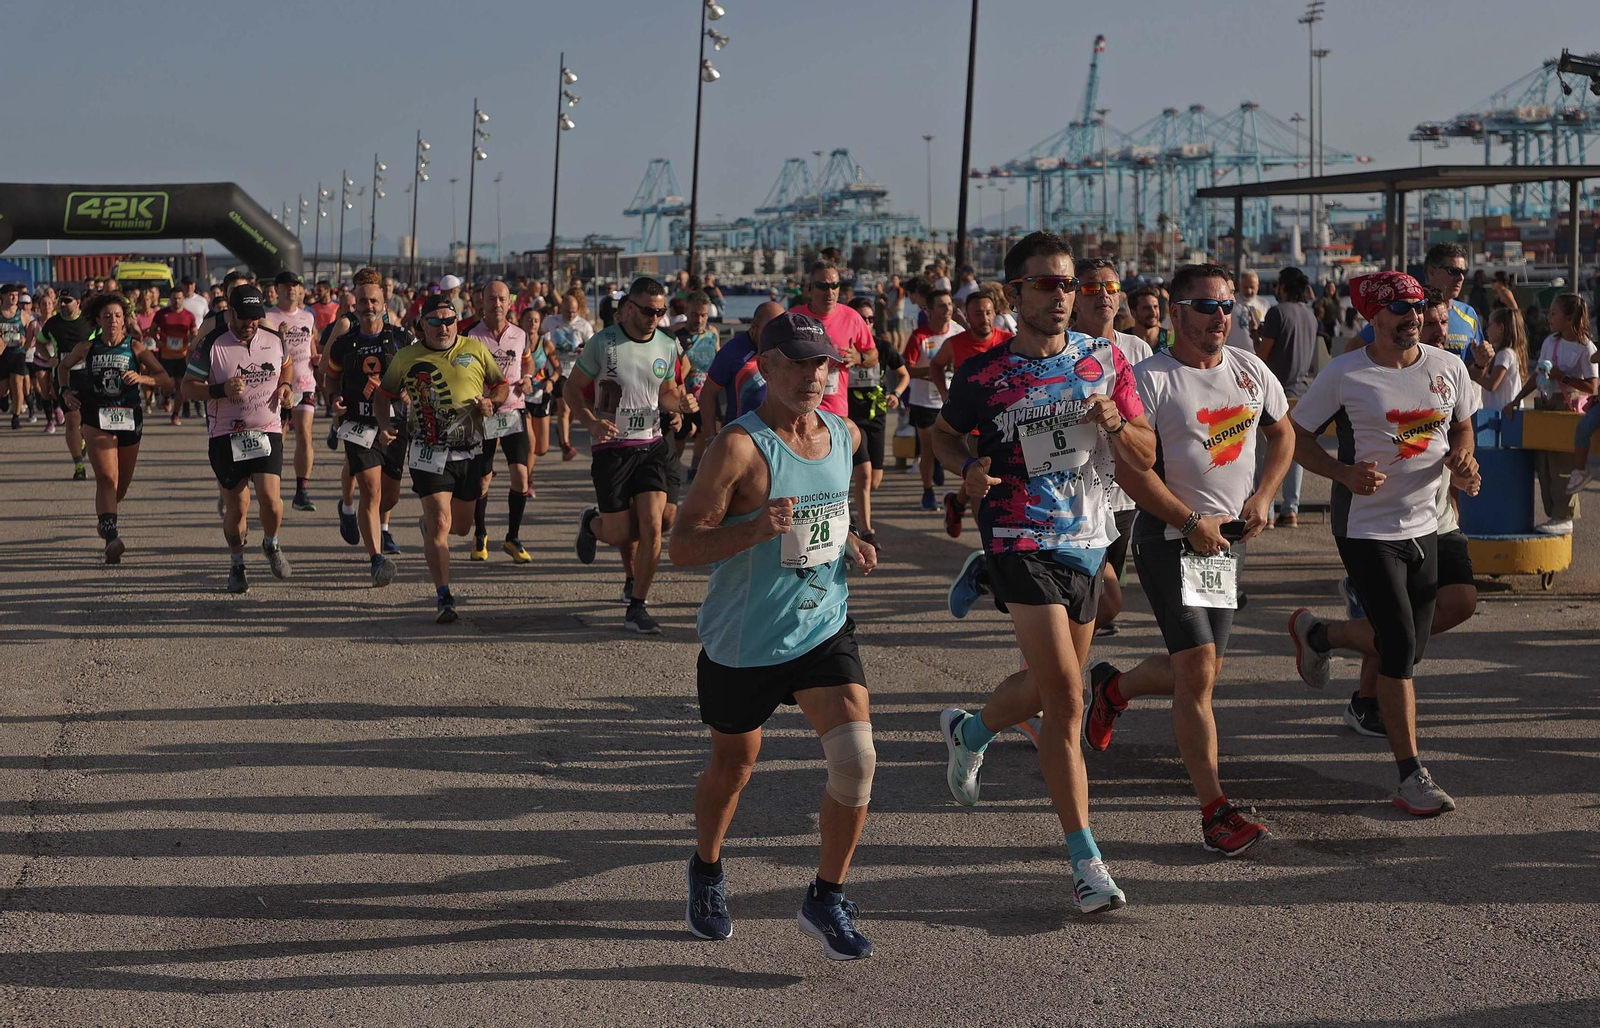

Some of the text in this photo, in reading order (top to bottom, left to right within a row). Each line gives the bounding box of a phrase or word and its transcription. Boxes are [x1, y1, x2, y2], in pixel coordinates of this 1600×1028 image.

[76, 197, 156, 220] 42K
[108, 218, 152, 230] running
[228, 210, 278, 254] 42krunning.com
[860, 370, 871, 380] 61
[110, 414, 124, 422] 197
[1016, 404, 1050, 424] MEDIA
[628, 416, 644, 428] 170
[1026, 417, 1058, 431] XXVI
[352, 424, 364, 434] 46
[1202, 415, 1255, 451] HISPANOS
[1391, 417, 1446, 445] HISPANOS
[242, 438, 260, 449] 135
[1053, 430, 1067, 450] 6
[420, 448, 434, 460] 90
[801, 491, 830, 504] EDICIÓN
[792, 508, 824, 519] XXVI
[810, 520, 830, 545] 28
[806, 544, 821, 552] SAMUEL
[1200, 570, 1222, 589] 154
